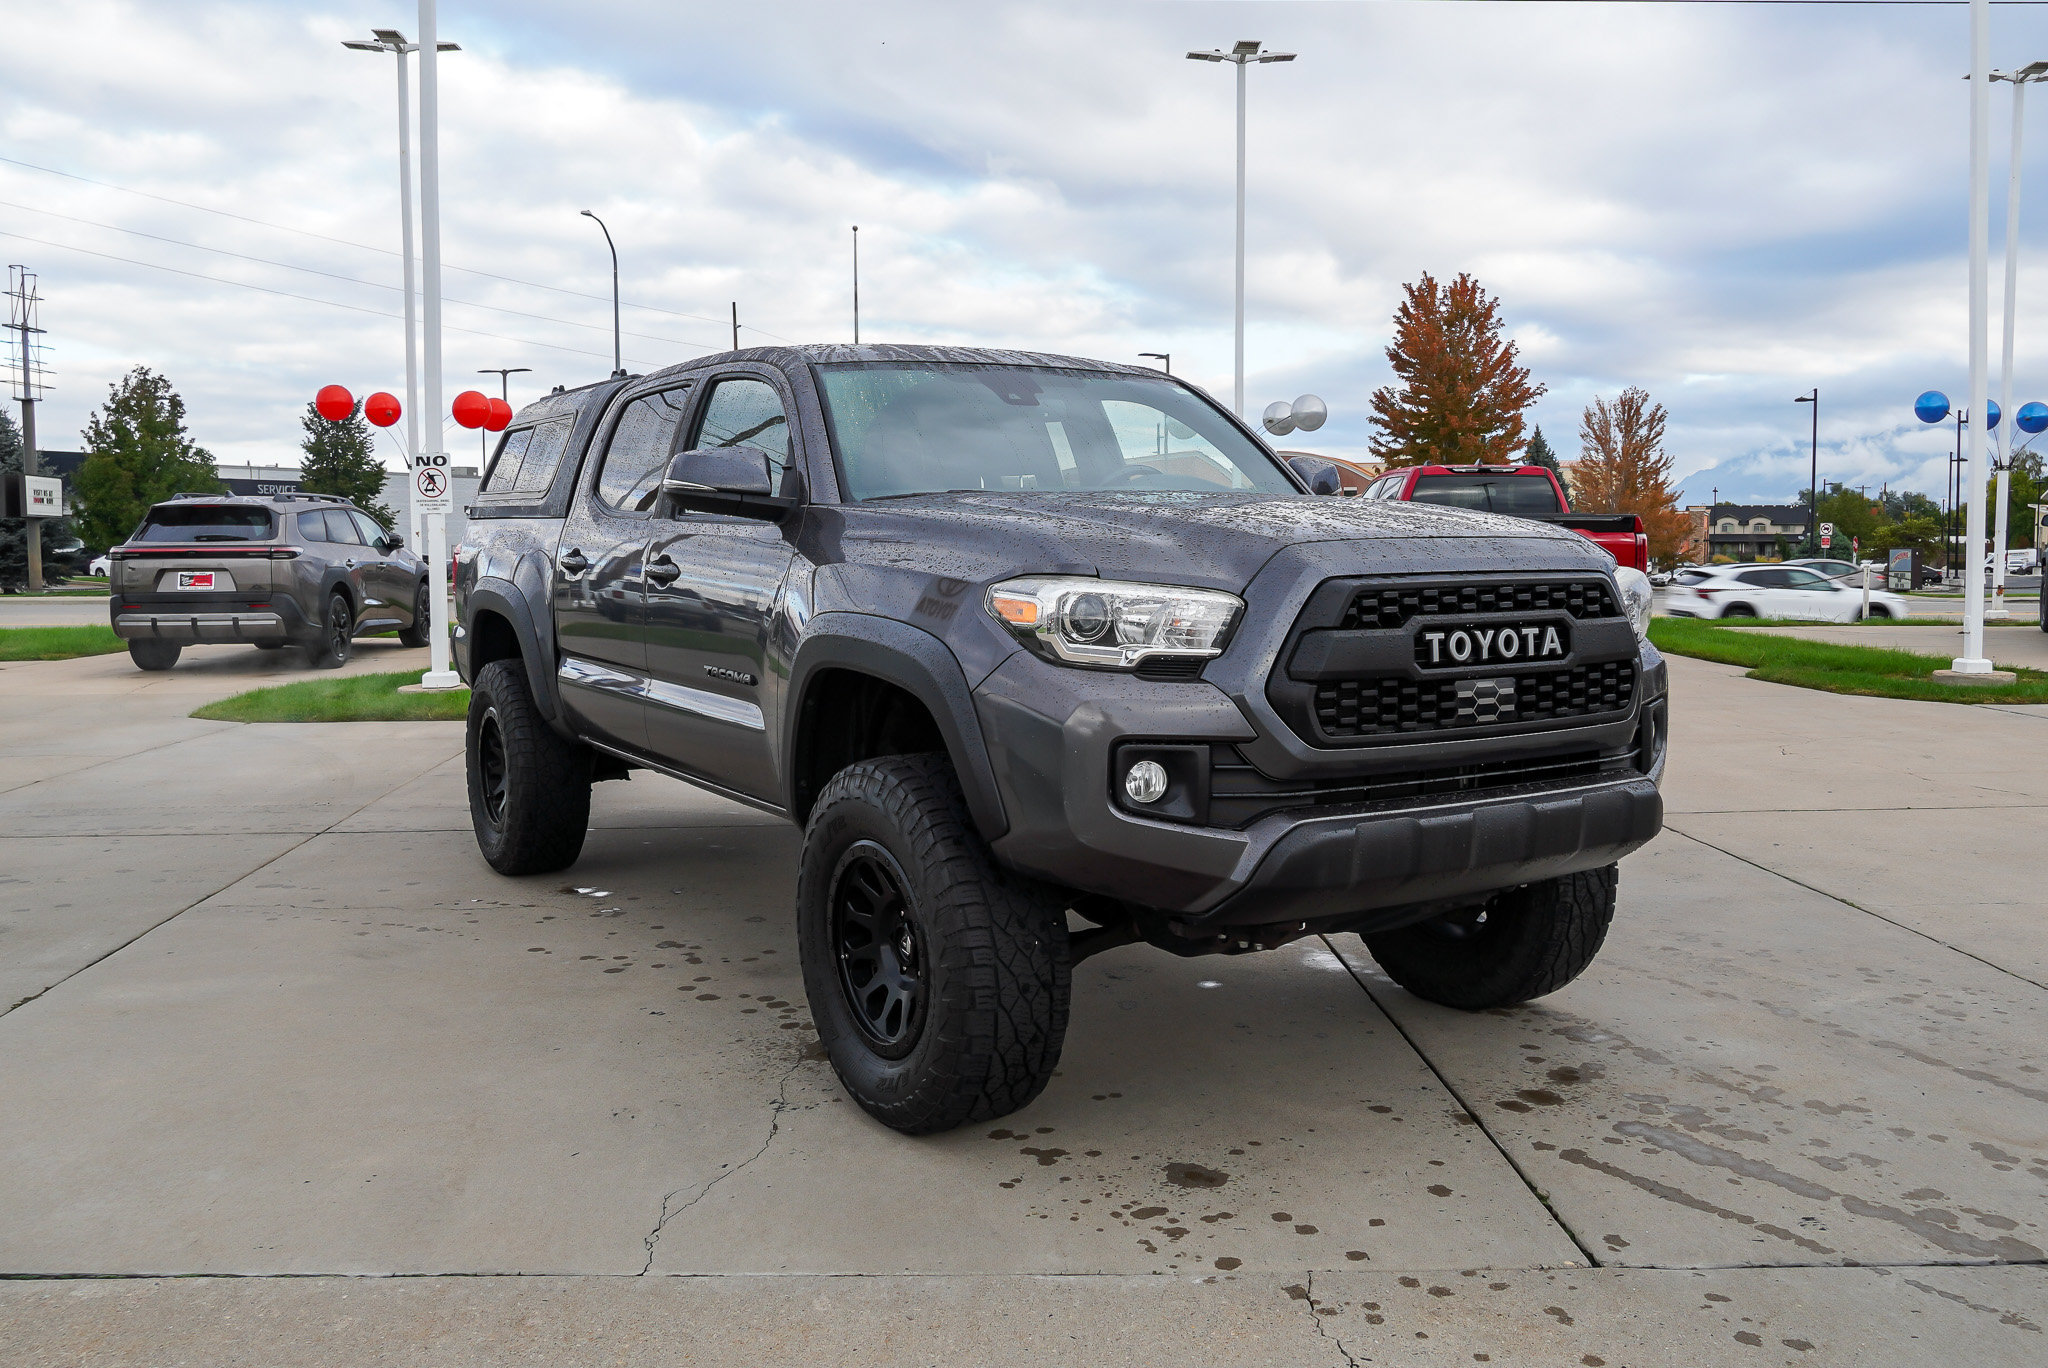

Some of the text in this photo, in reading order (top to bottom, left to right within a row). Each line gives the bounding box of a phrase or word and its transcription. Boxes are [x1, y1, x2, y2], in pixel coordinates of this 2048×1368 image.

[416, 455, 447, 466] NO
[257, 484, 297, 495] SERVICE
[1425, 626, 1563, 662] TOYOTA
[703, 664, 751, 685] TACOMA
